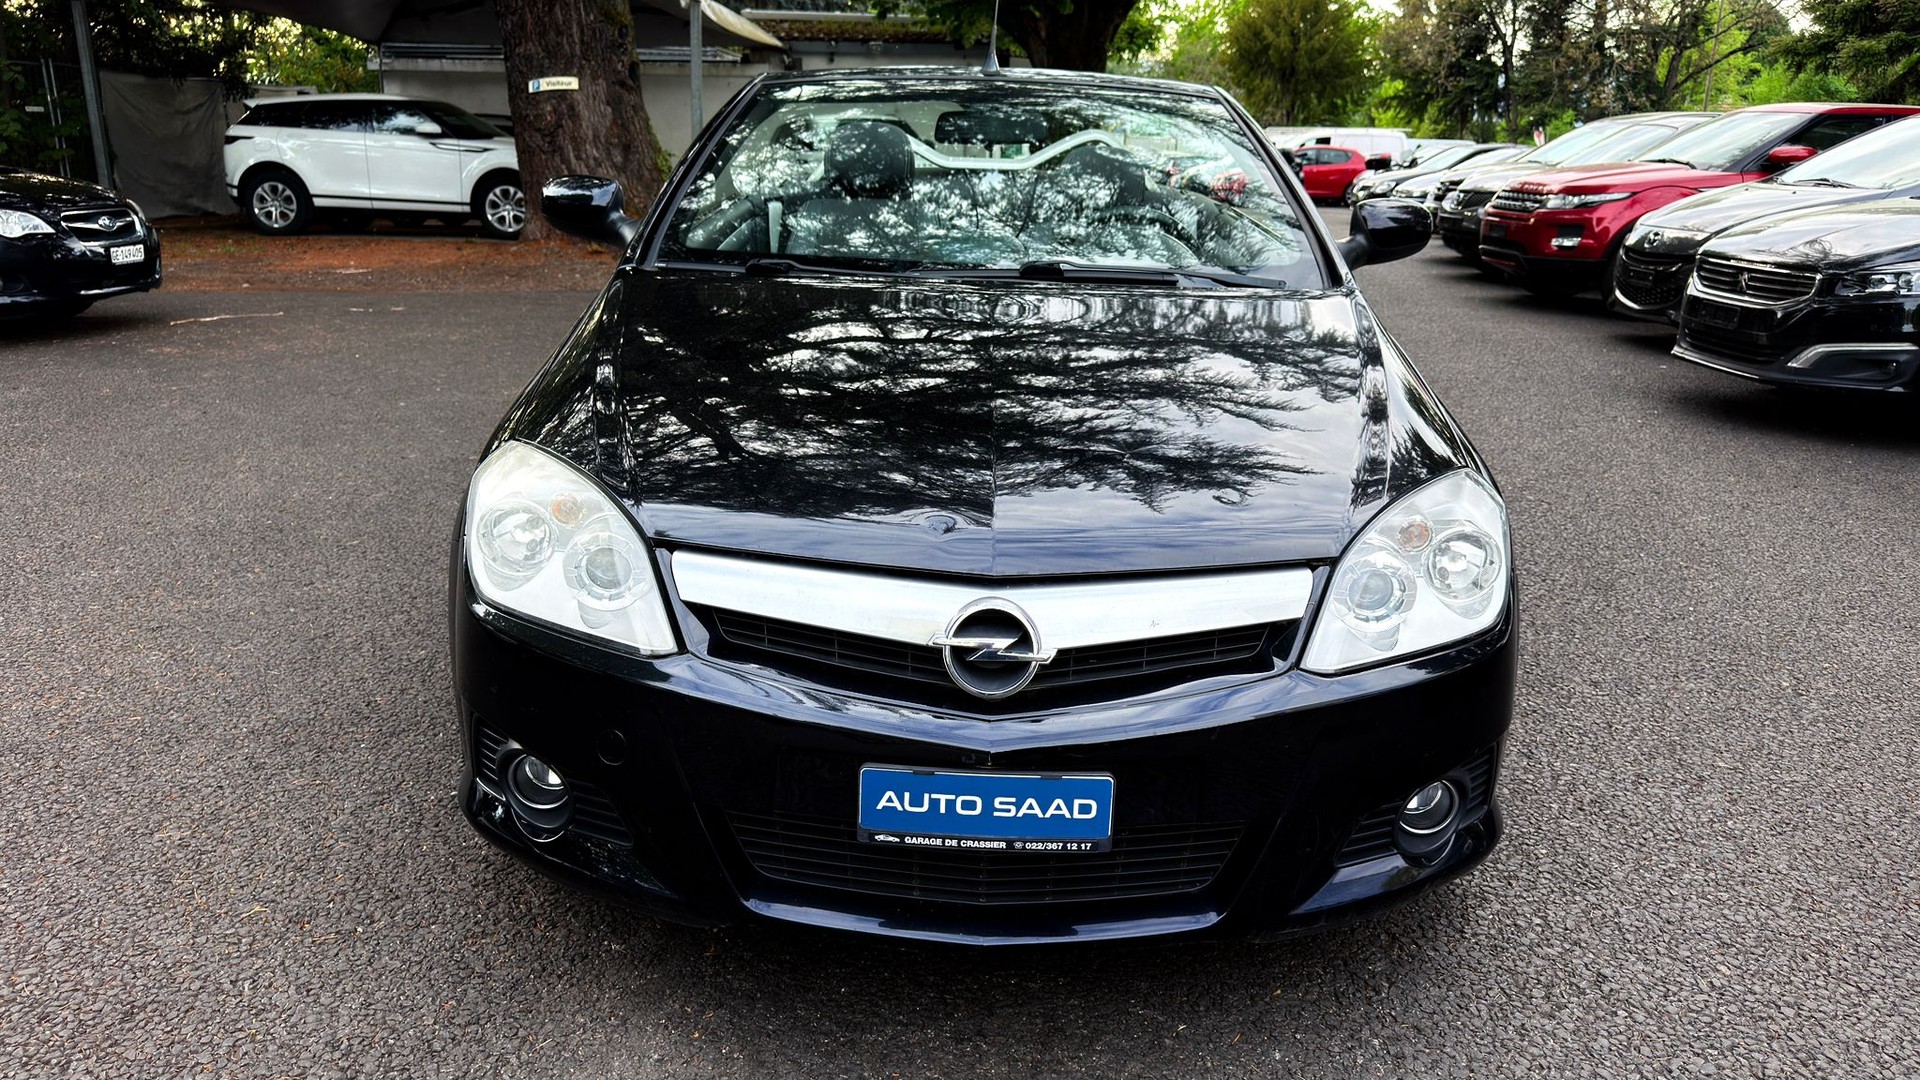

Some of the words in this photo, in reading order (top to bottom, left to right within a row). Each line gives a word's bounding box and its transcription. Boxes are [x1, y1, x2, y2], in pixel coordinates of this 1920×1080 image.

[876, 790, 982, 815] AUTO
[993, 797, 1098, 819] SAAD
[904, 836, 943, 846] GARAGE
[944, 839, 958, 847] DE
[960, 840, 1007, 849] CRASSIER
[1025, 842, 1063, 850] 022/367
[1066, 842, 1078, 850] 12
